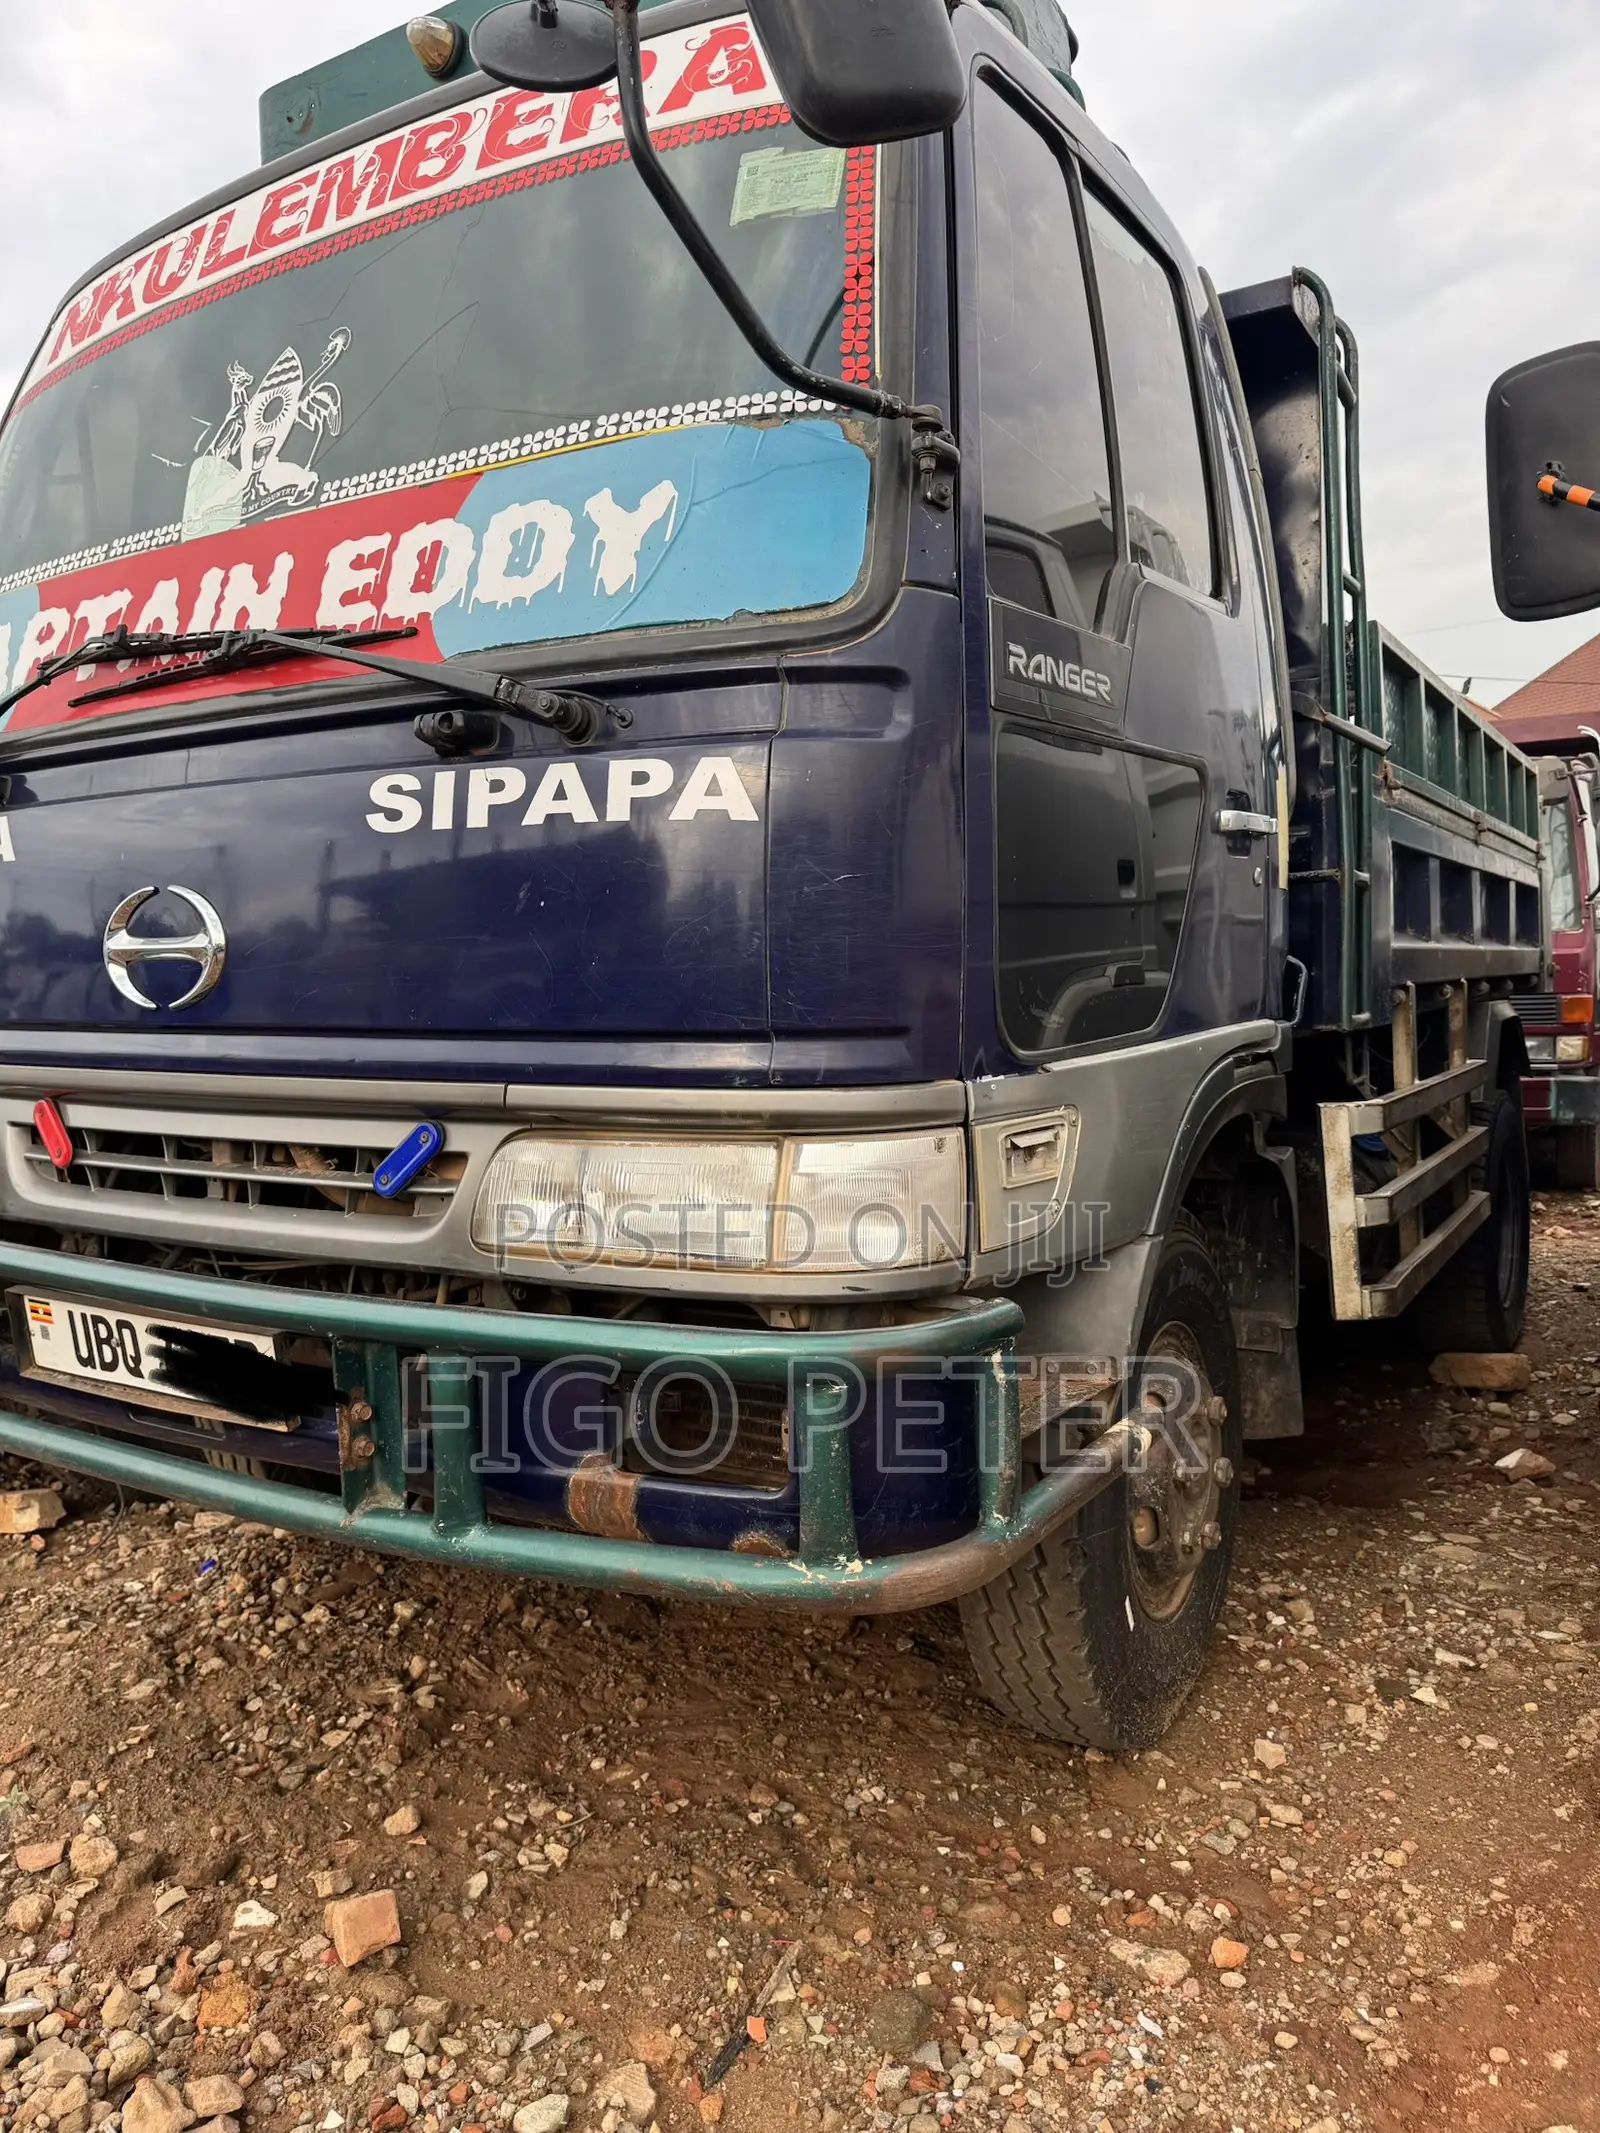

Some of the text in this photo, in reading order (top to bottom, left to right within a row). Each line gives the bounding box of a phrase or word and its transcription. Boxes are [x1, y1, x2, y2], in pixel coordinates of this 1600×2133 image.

[260, 486, 296, 507] COUNTRY
[1006, 641, 1114, 705] RANGER
[365, 755, 760, 834] SIPAPA
[67, 1309, 145, 1379] UBQ
